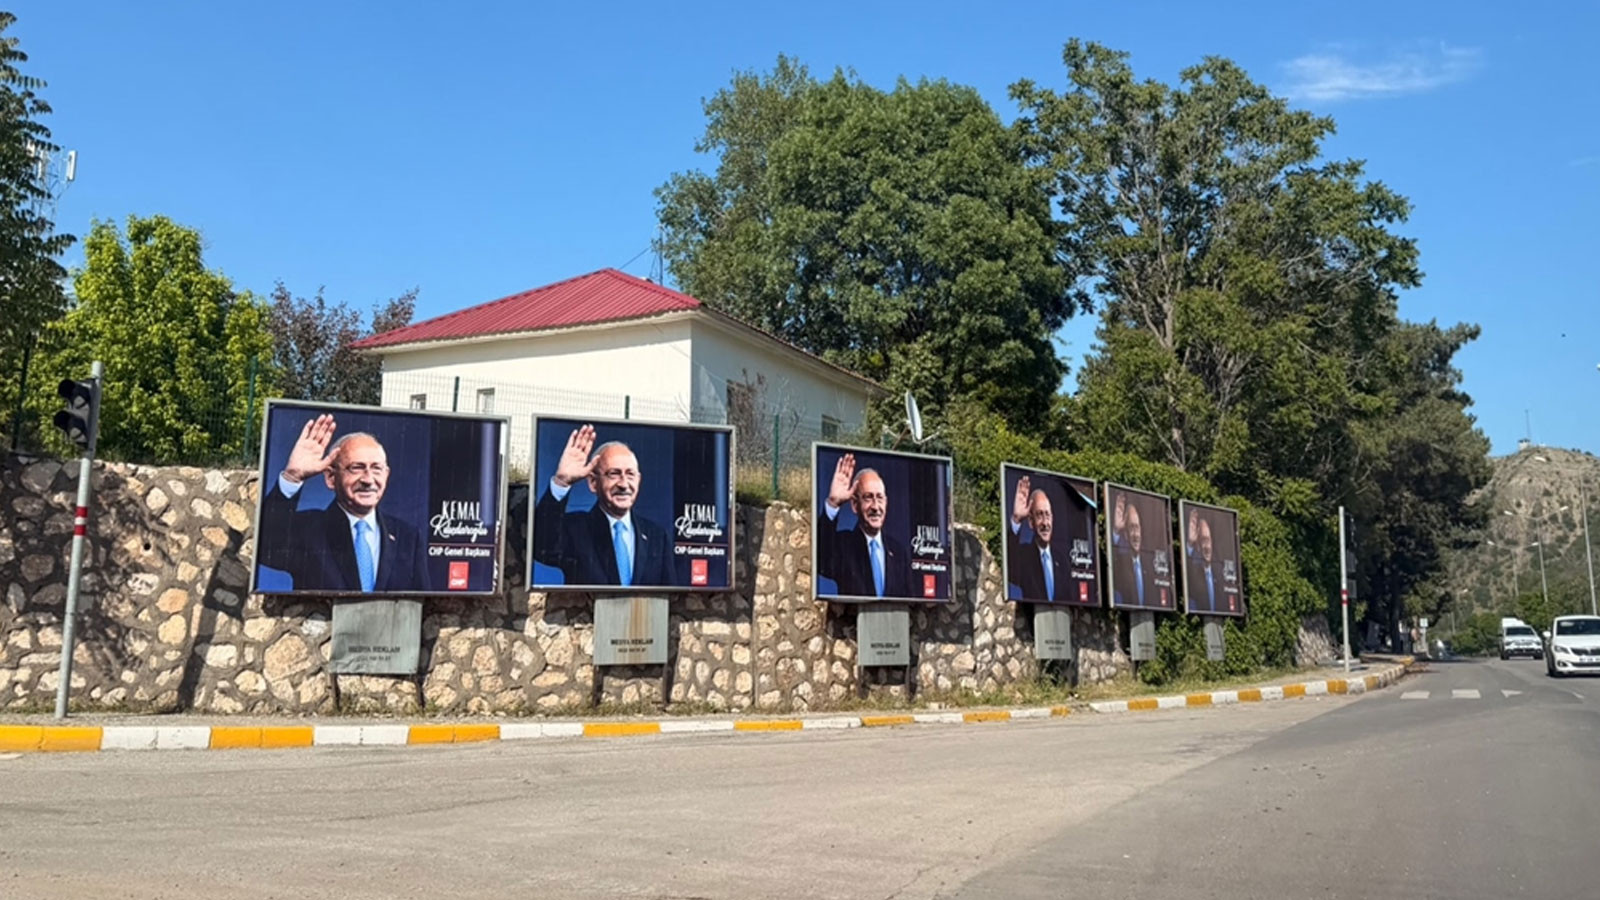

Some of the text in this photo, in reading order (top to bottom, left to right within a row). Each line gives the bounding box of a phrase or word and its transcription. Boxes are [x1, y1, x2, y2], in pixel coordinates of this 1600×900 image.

[442, 500, 481, 521] KEMAL
[684, 503, 716, 522] KEMAL
[428, 546, 444, 556] CHP
[444, 546, 464, 556] Genel
[674, 545, 687, 554] CHP
[687, 546, 703, 555] Genel
